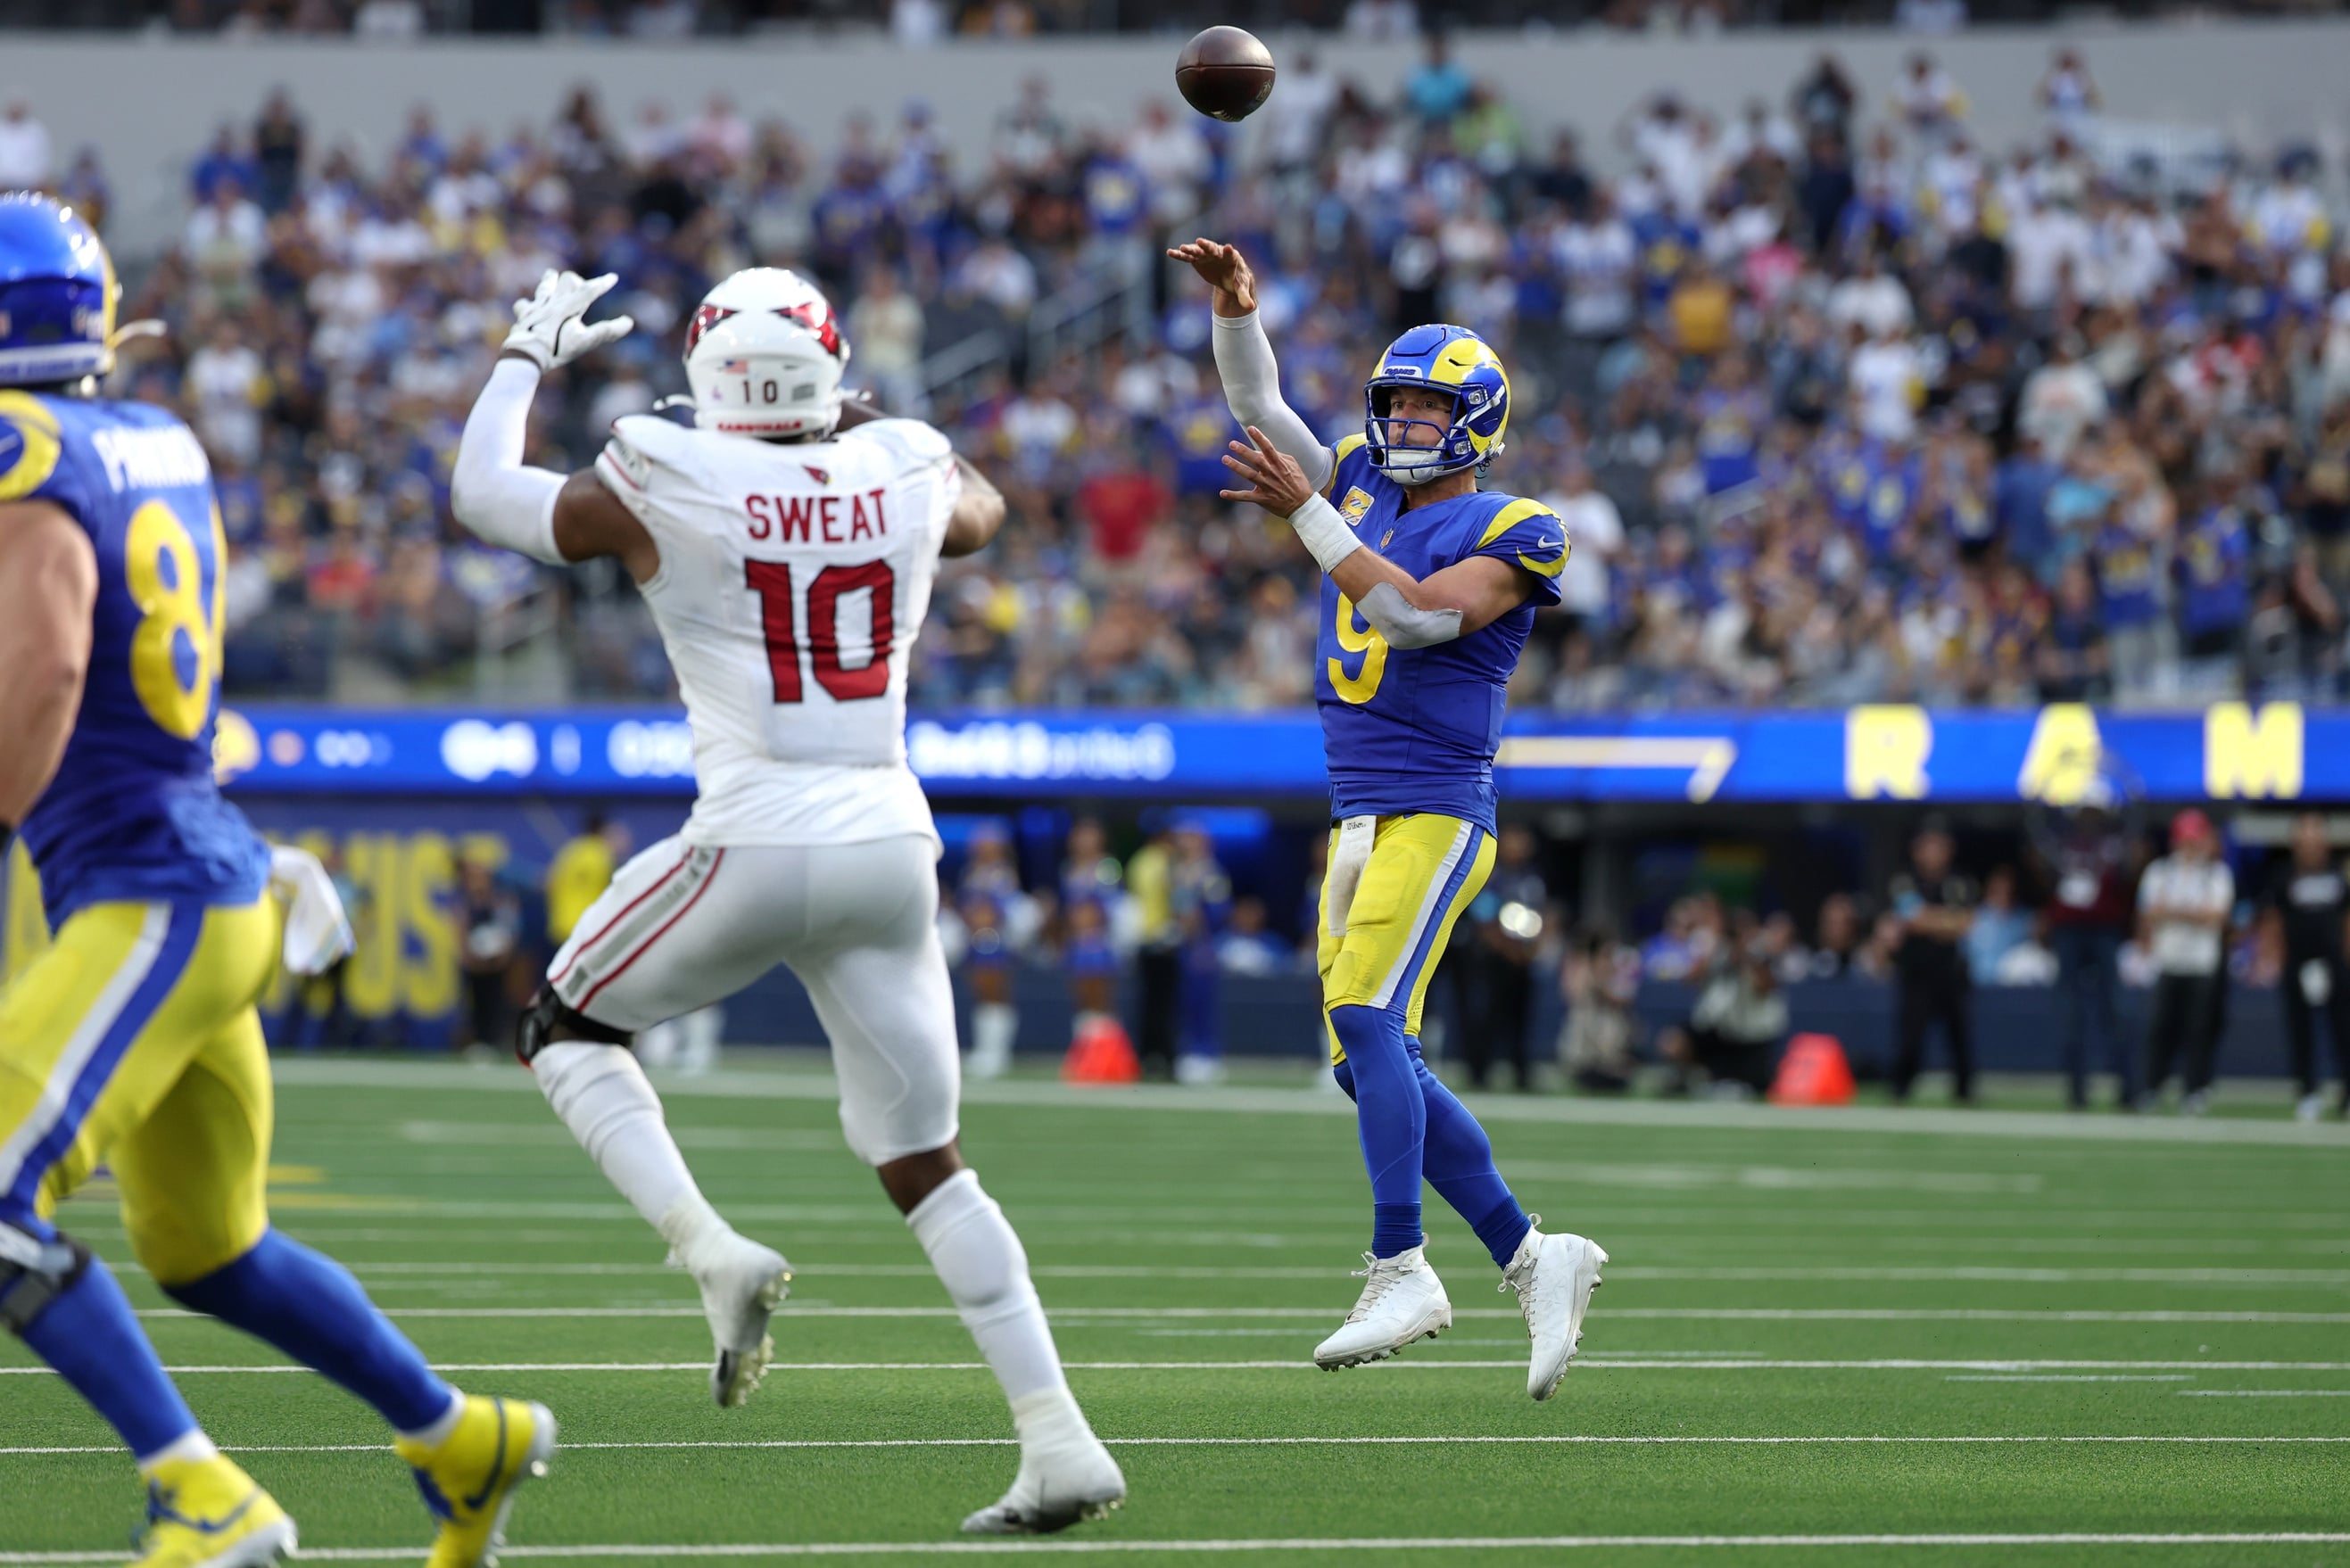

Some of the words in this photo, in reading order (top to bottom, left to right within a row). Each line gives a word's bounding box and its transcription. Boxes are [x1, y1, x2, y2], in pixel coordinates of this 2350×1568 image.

[743, 380, 777, 404] 10
[746, 488, 886, 543] SWEAT
[744, 557, 895, 703] 10
[1328, 590, 1389, 705] 9
